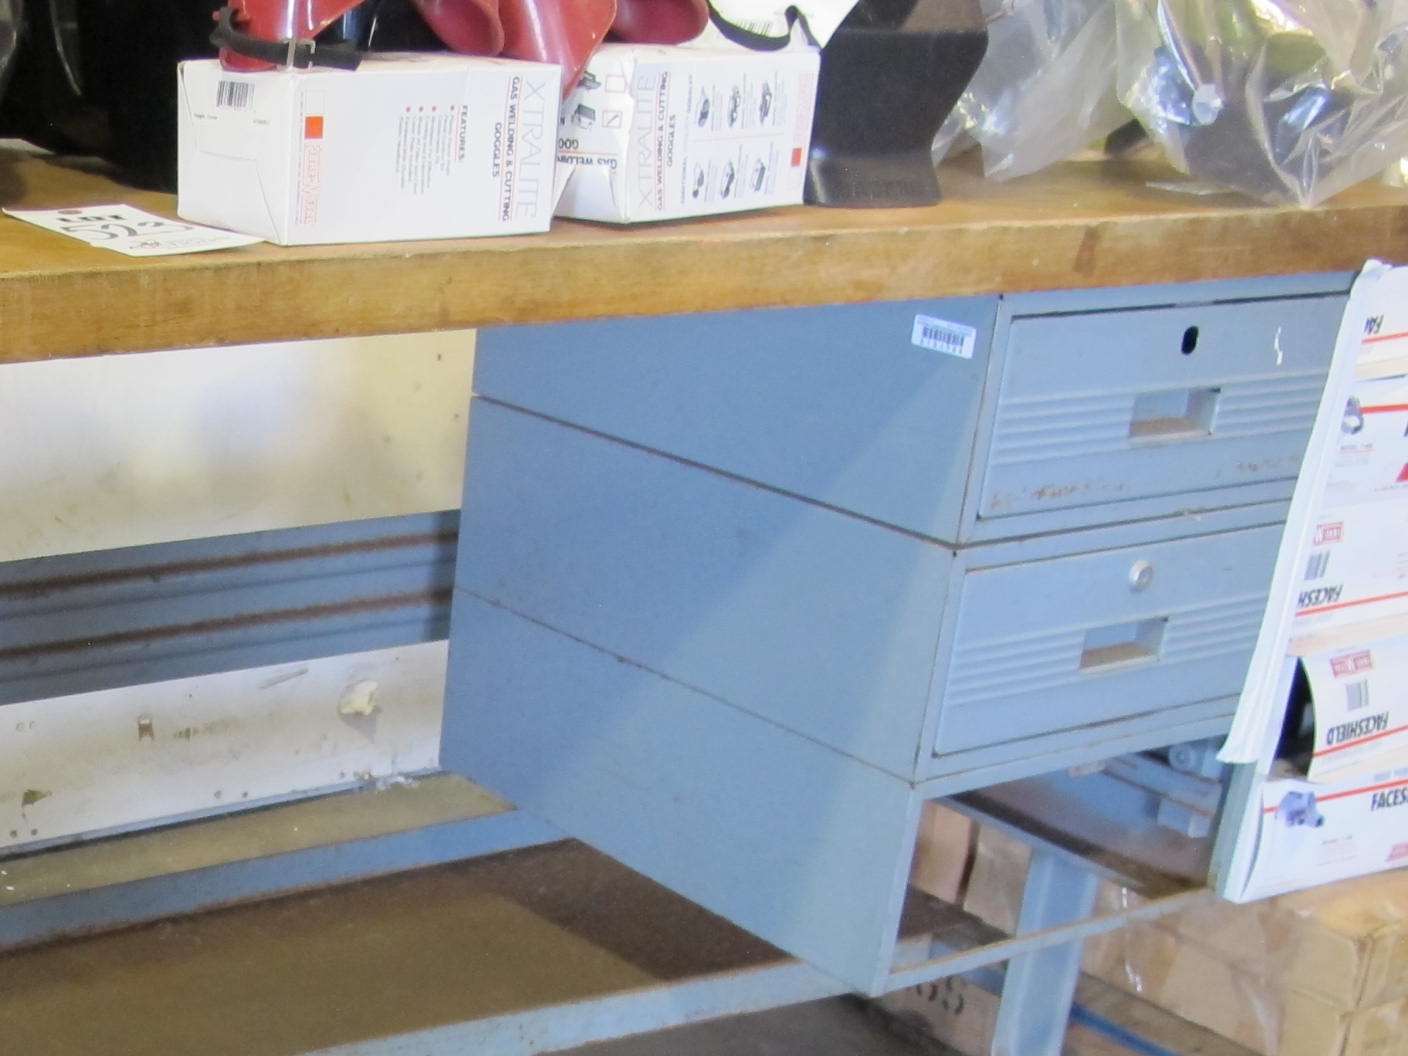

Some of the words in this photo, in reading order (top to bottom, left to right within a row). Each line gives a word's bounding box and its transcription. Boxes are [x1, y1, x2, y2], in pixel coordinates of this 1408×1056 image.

[510, 76, 520, 100] GAS
[658, 72, 667, 121] CUTTING
[493, 122, 502, 178] GOGGLES
[506, 105, 516, 155] WELDING
[516, 81, 546, 218] XTRALITE
[667, 115, 676, 167] GOGGLES
[502, 171, 513, 222] CUTTING
[1327, 711, 1390, 746] FACESHIELD
